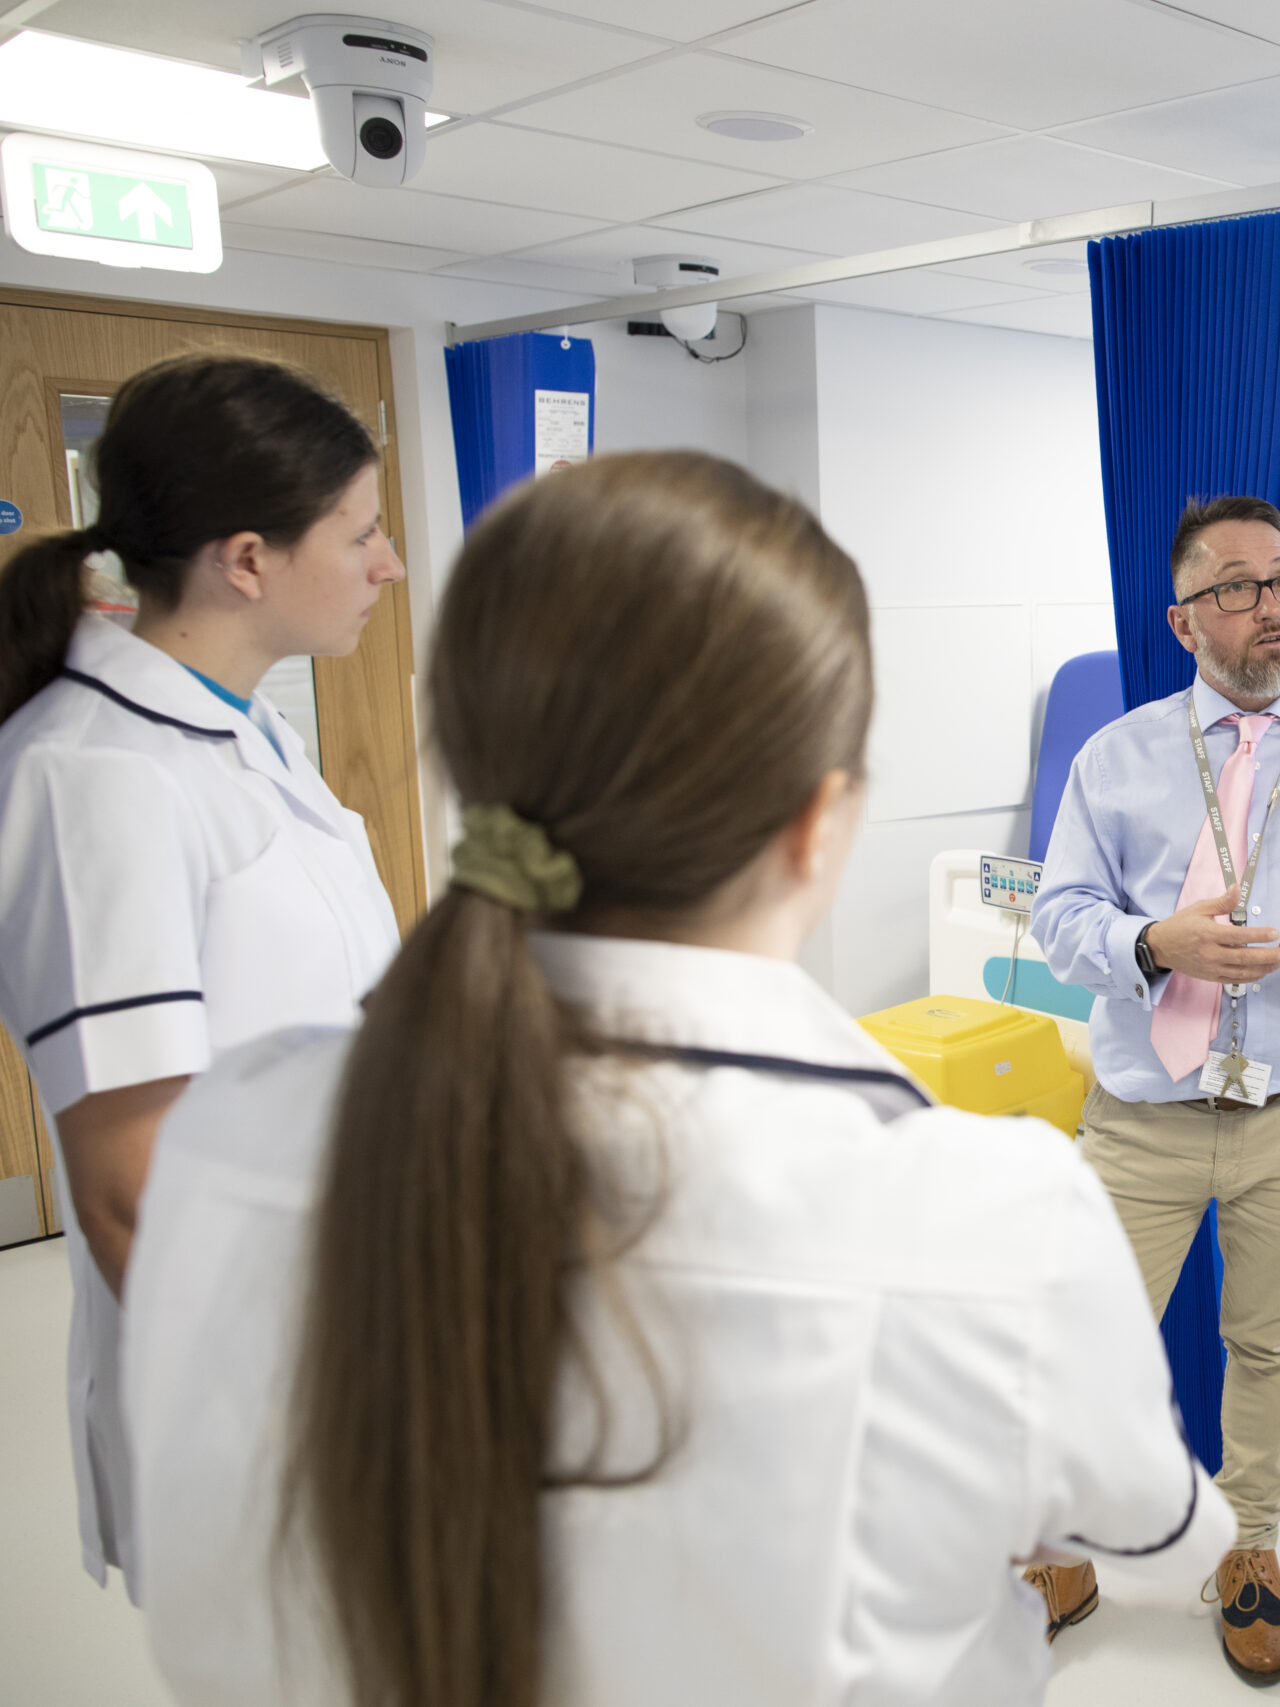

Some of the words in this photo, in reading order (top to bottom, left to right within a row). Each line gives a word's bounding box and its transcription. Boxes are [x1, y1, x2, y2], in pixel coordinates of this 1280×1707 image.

[1194, 737, 1206, 760] STAFF
[1202, 771, 1214, 794] STAFF
[1210, 806, 1223, 832] STAFF
[1219, 846, 1232, 873] STAFF
